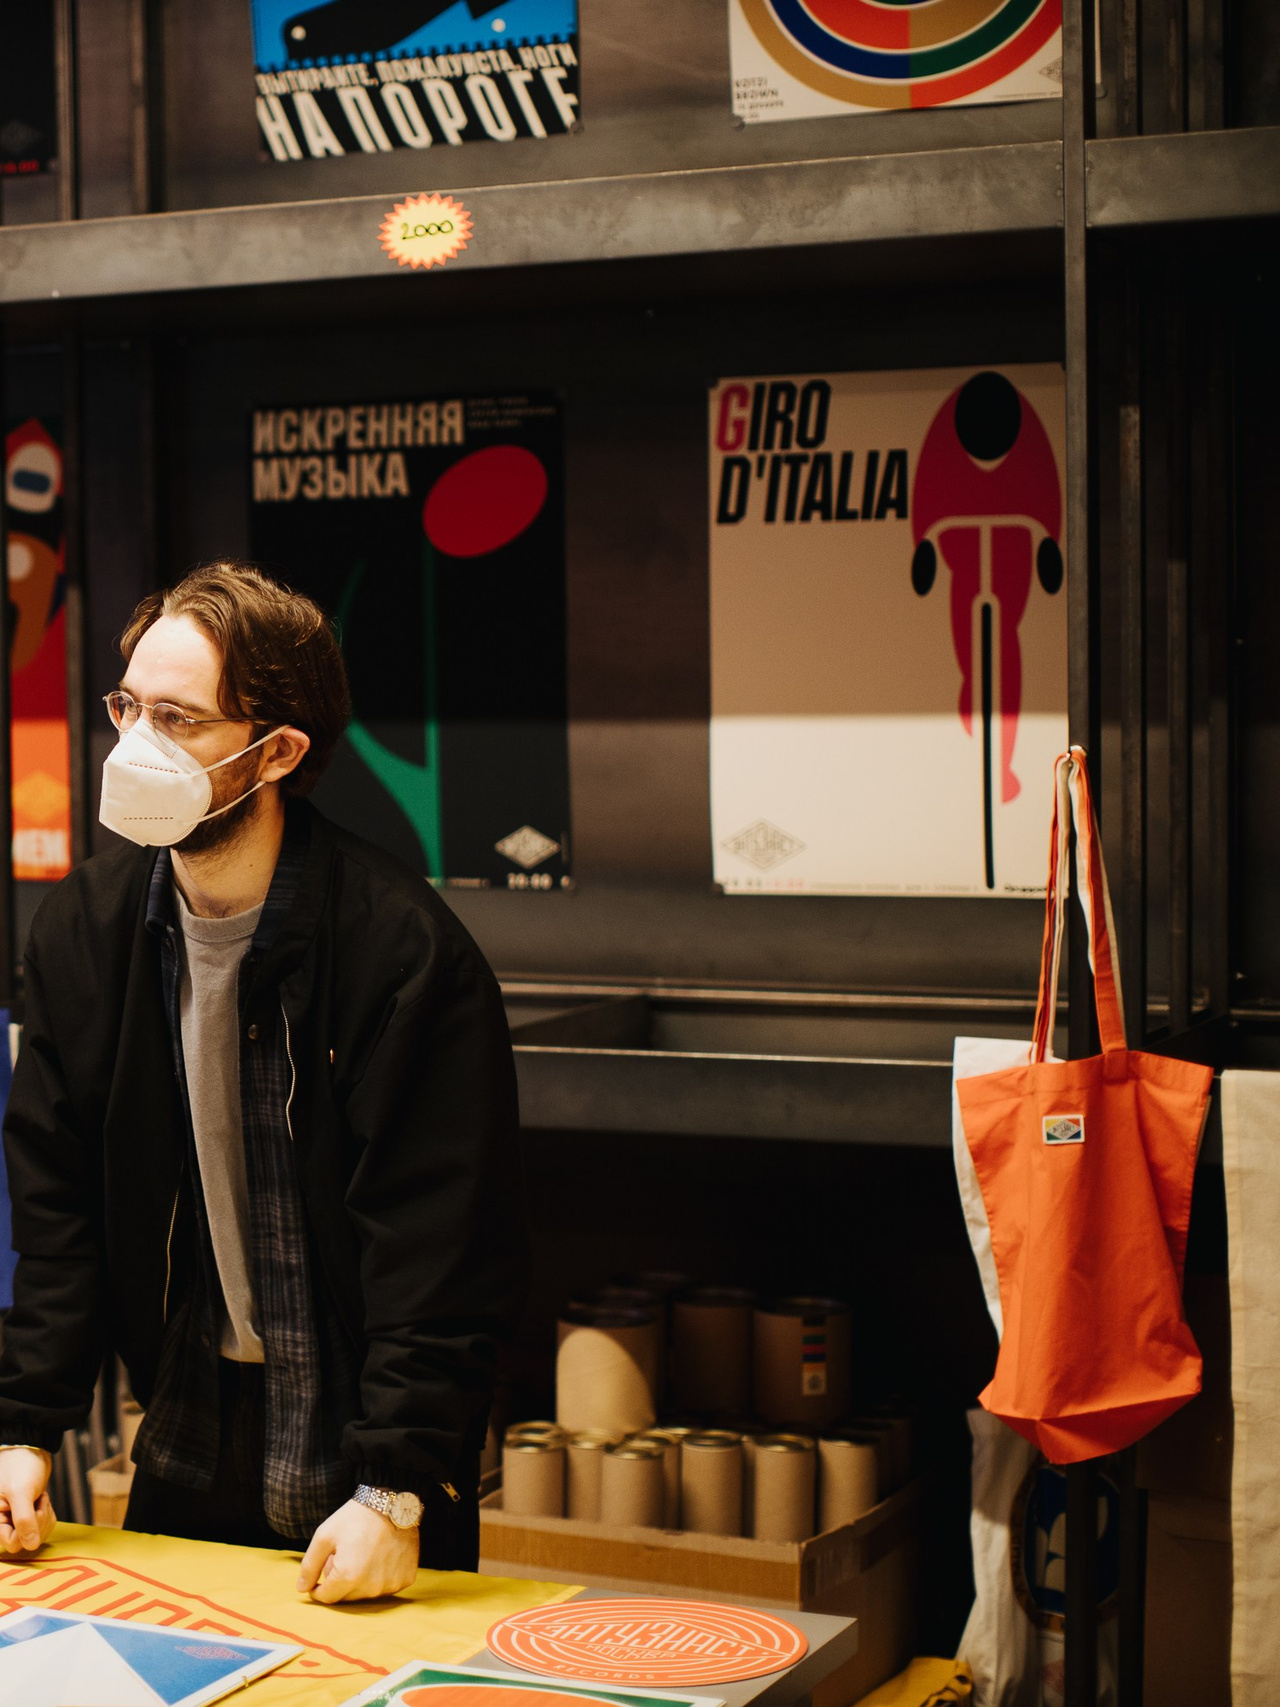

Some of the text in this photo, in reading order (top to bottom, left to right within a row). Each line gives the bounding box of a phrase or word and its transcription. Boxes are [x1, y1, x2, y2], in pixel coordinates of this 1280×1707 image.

[518, 43, 578, 71] НОГИ
[400, 219, 455, 241] 2000
[253, 400, 464, 454] ИСКРЕННЯЯ
[716, 379, 832, 453] GIRO
[253, 453, 410, 502] МУЗЫКА
[716, 449, 908, 524] D'ITALIA
[586, 1644, 677, 1660] МОСКВА
[553, 1664, 655, 1680] RECORDS
